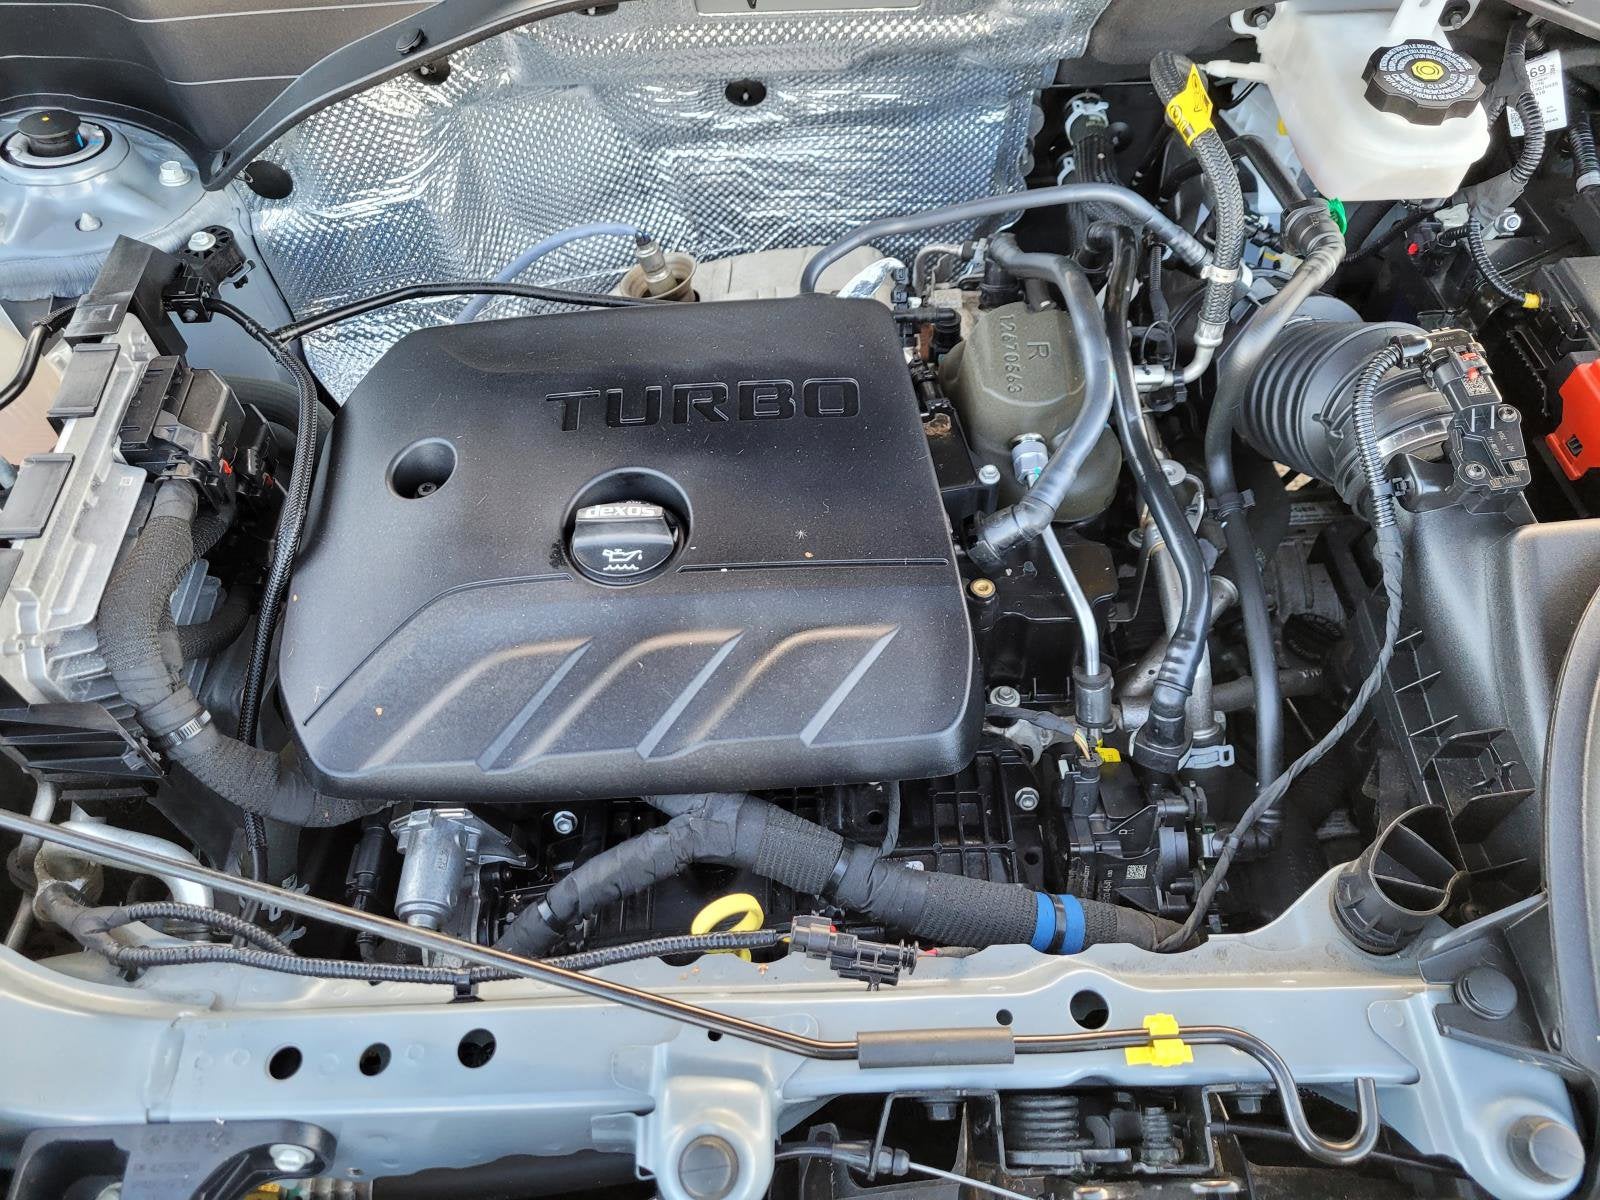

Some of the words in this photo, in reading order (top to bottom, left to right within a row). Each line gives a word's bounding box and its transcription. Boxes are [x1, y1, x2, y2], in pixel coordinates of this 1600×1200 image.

[1026, 341, 1051, 361] R
[545, 377, 861, 432] TURBO
[584, 504, 657, 519] dexos
